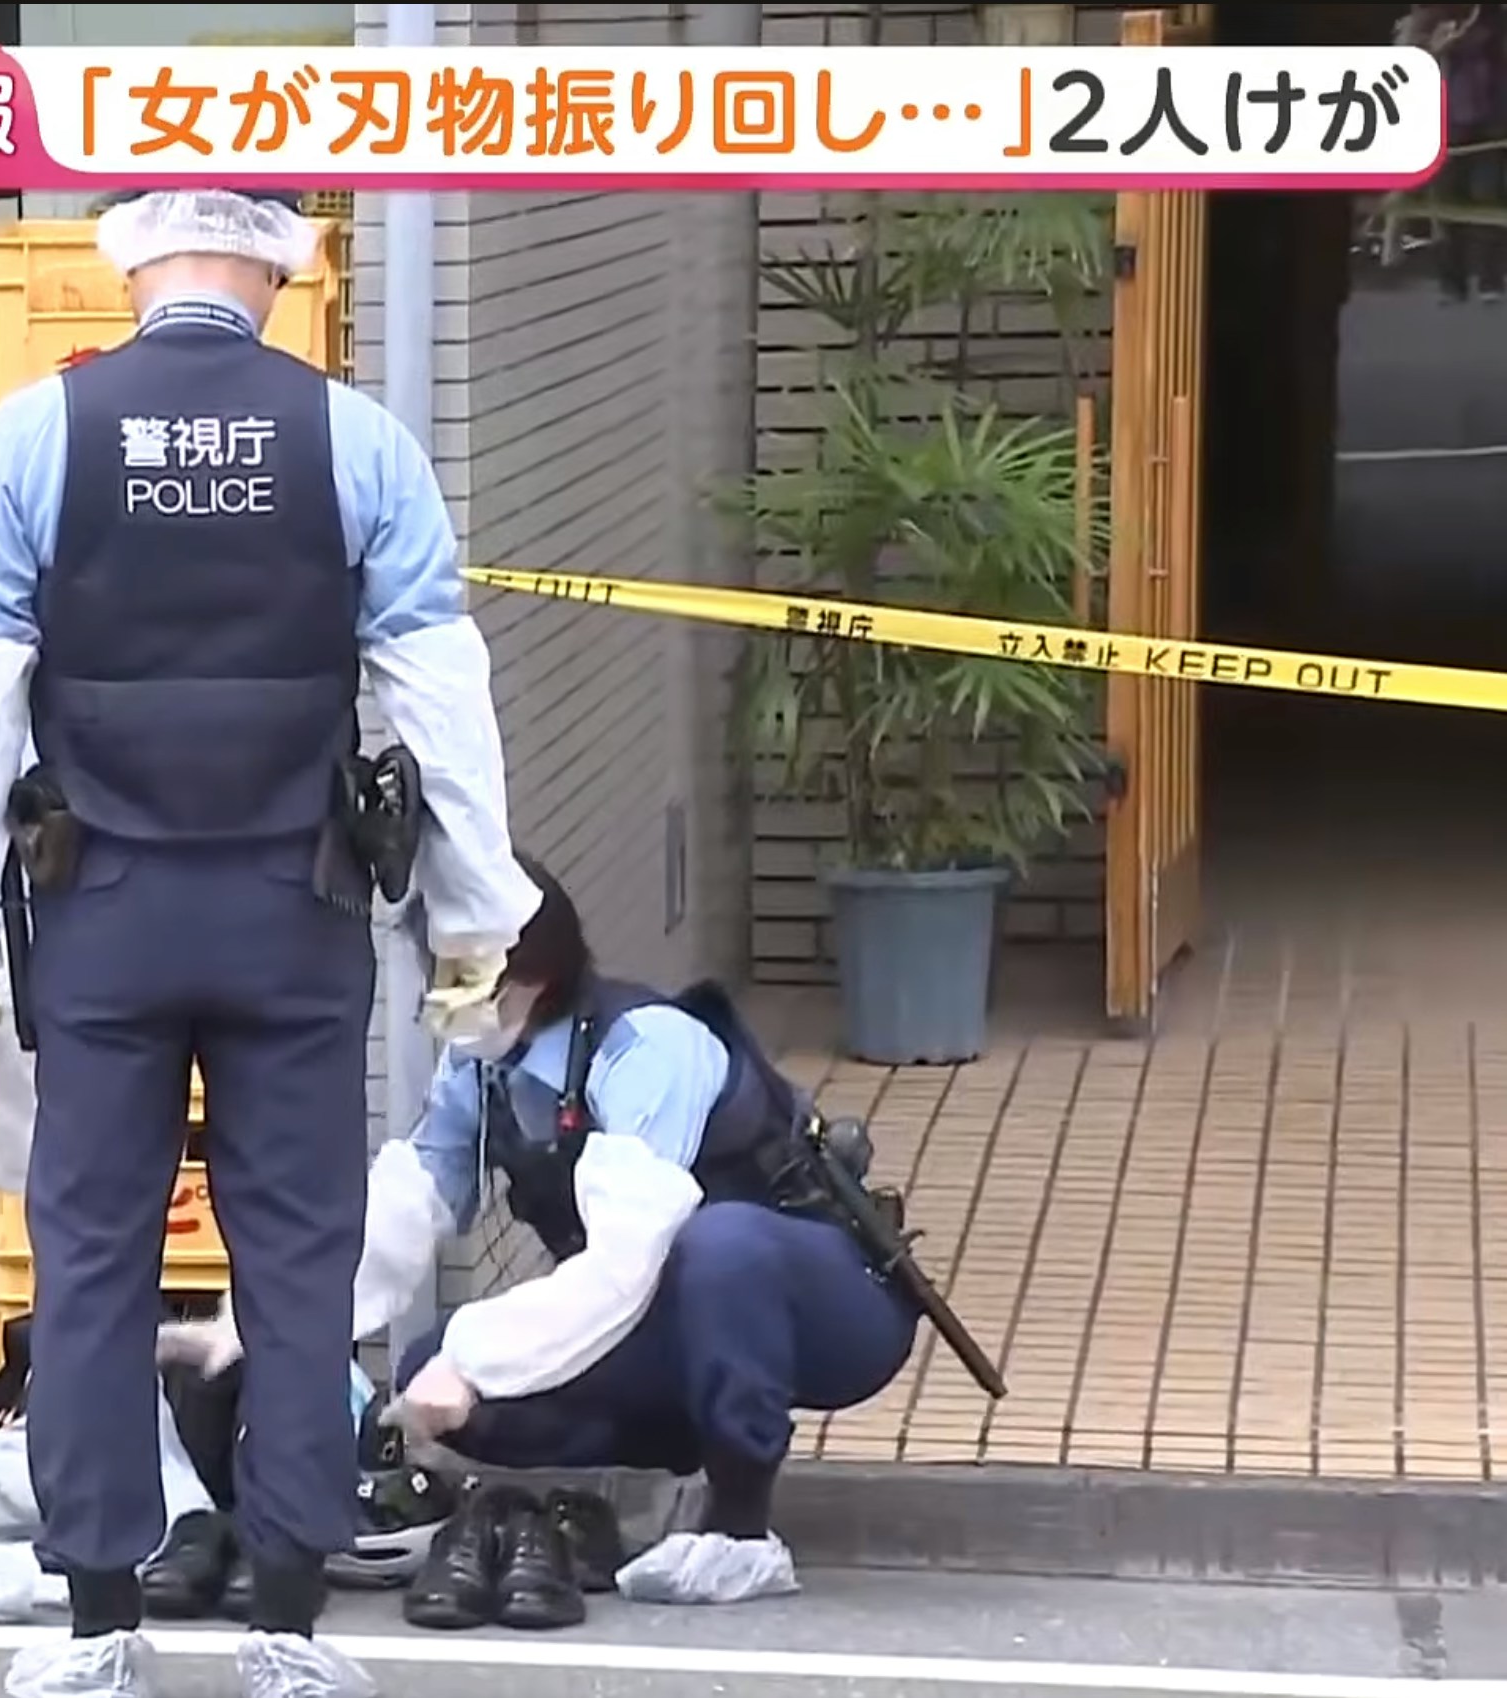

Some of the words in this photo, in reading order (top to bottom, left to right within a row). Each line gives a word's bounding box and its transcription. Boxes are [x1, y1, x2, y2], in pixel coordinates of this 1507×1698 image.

[120, 416, 277, 469] 警視庁
[126, 477, 275, 515] POLICE
[997, 631, 1121, 669] 立入禁止
[1144, 646, 1273, 682] KEEP
[1296, 661, 1392, 695] OUT
